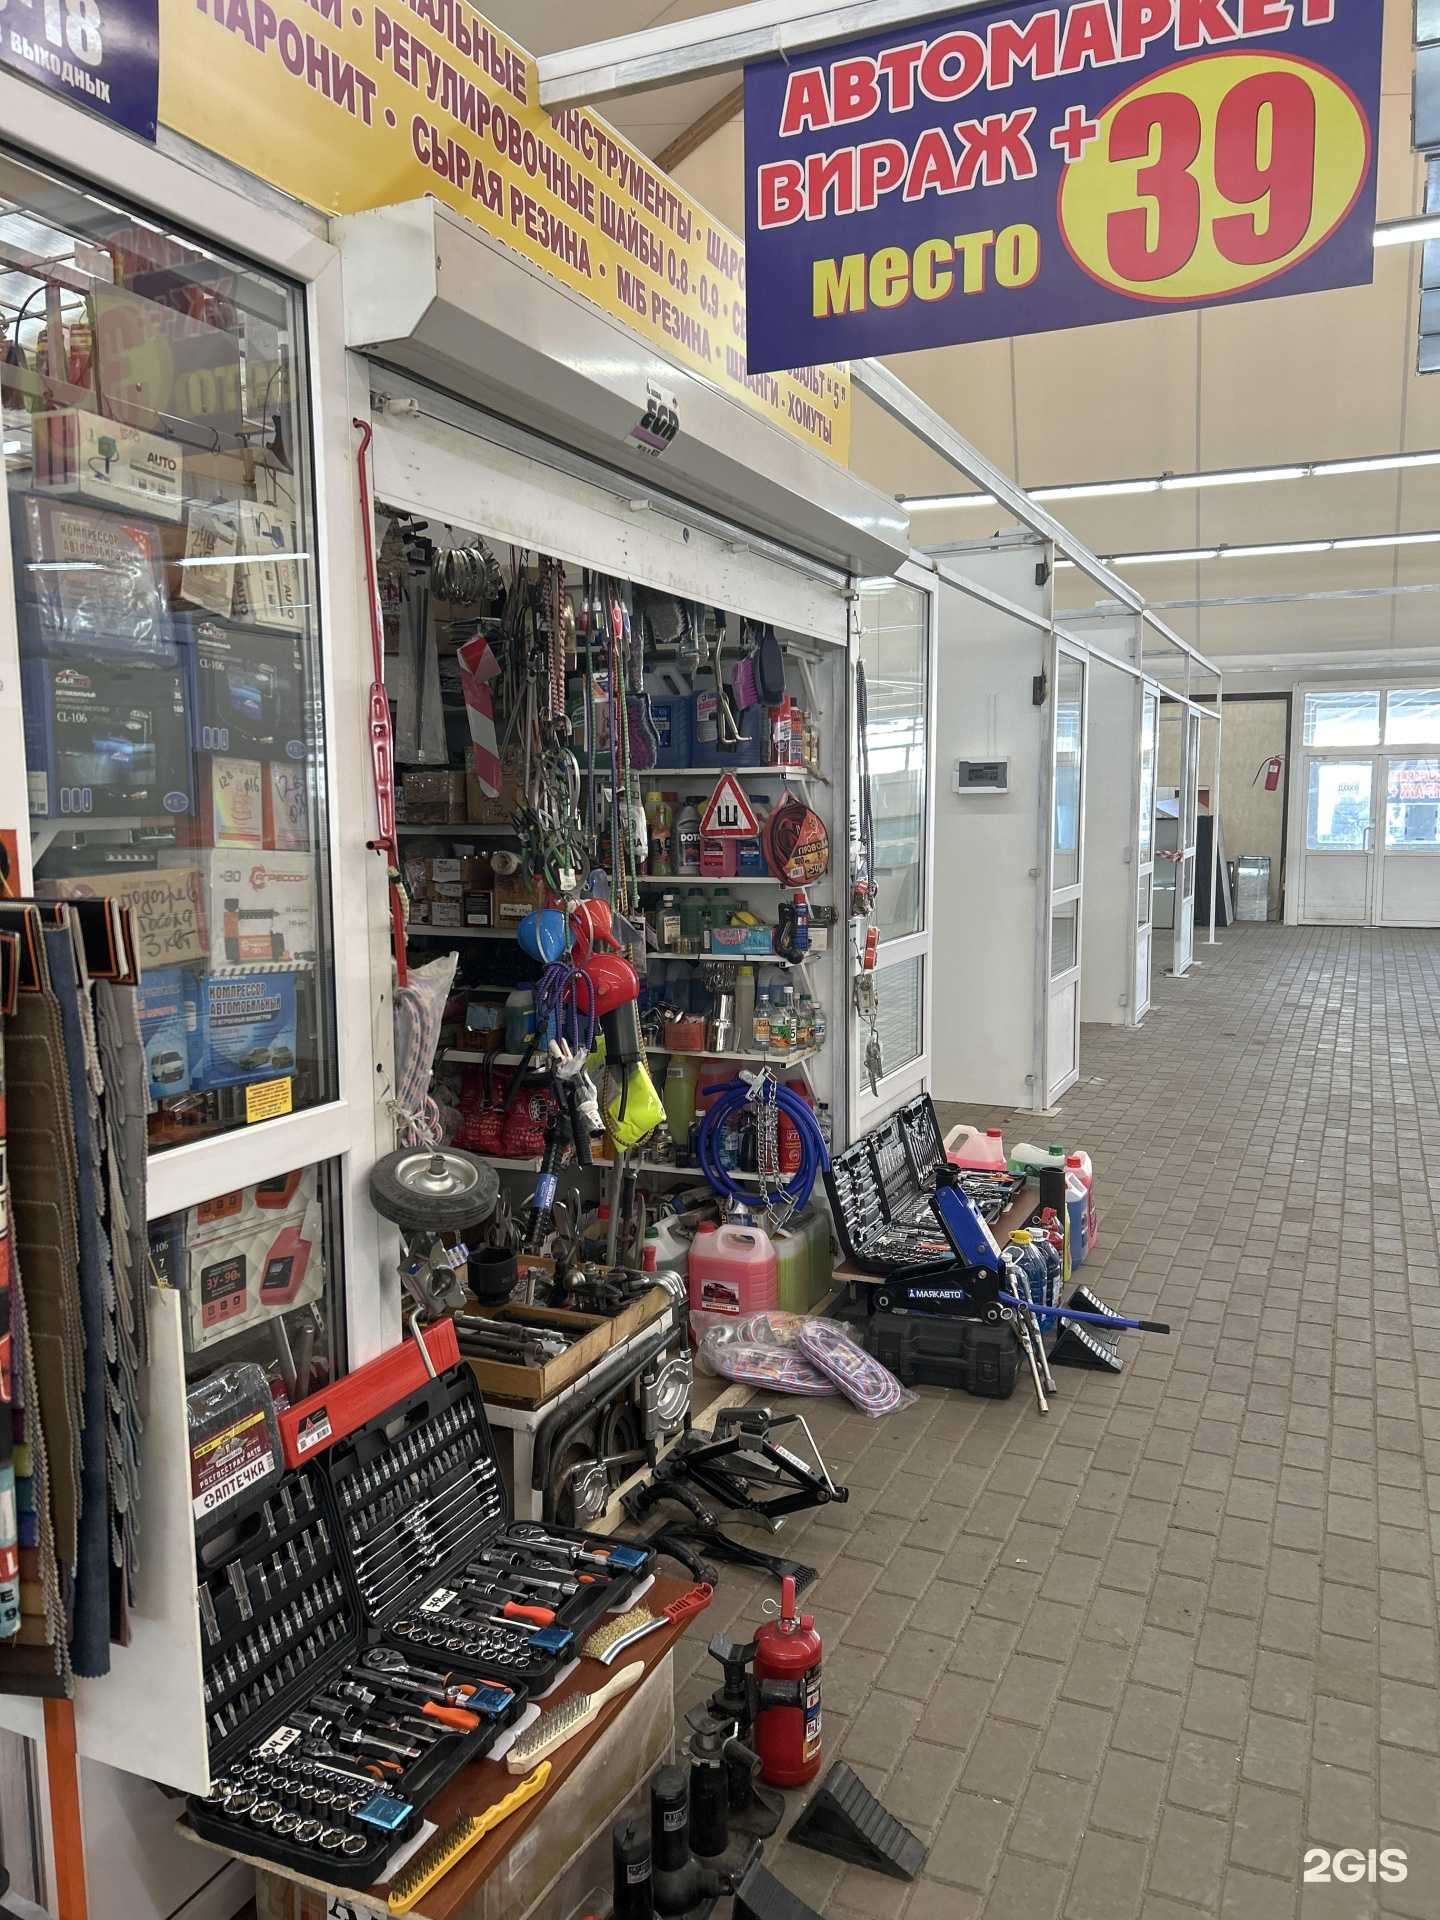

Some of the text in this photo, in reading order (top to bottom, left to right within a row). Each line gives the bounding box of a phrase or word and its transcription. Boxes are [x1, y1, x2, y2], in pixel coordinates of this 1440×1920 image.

[10, 30, 111, 104] ВЫХОДНЫХ
[374, 6, 595, 224] РЕГУЛИРОВОЧНЫЕ
[600, 191, 664, 277] ШАЙБЫ
[668, 248, 688, 295] 0.8
[699, 274, 719, 319] 0.9
[551, 106, 692, 244] ИНСТРУМЕНТЫ
[758, 108, 1037, 230] ВИРАЖ
[1106, 71, 1317, 282] 39
[412, 115, 503, 217] СЫРАЯ
[510, 185, 592, 278] РЕЗИНА
[616, 263, 648, 316] М/Б
[651, 288, 713, 362] РЕЗИНА
[787, 390, 832, 445] ХОМУТЫ
[147, 451, 178, 472] AUTO
[56, 711, 88, 724] CL-106
[717, 805, 738, 827] Ш
[207, 983, 266, 1000] КОМПРЕССОР
[916, 1290, 961, 1299] МАЯКАВТО
[215, 1461, 266, 1503] АПТЕЧКА
